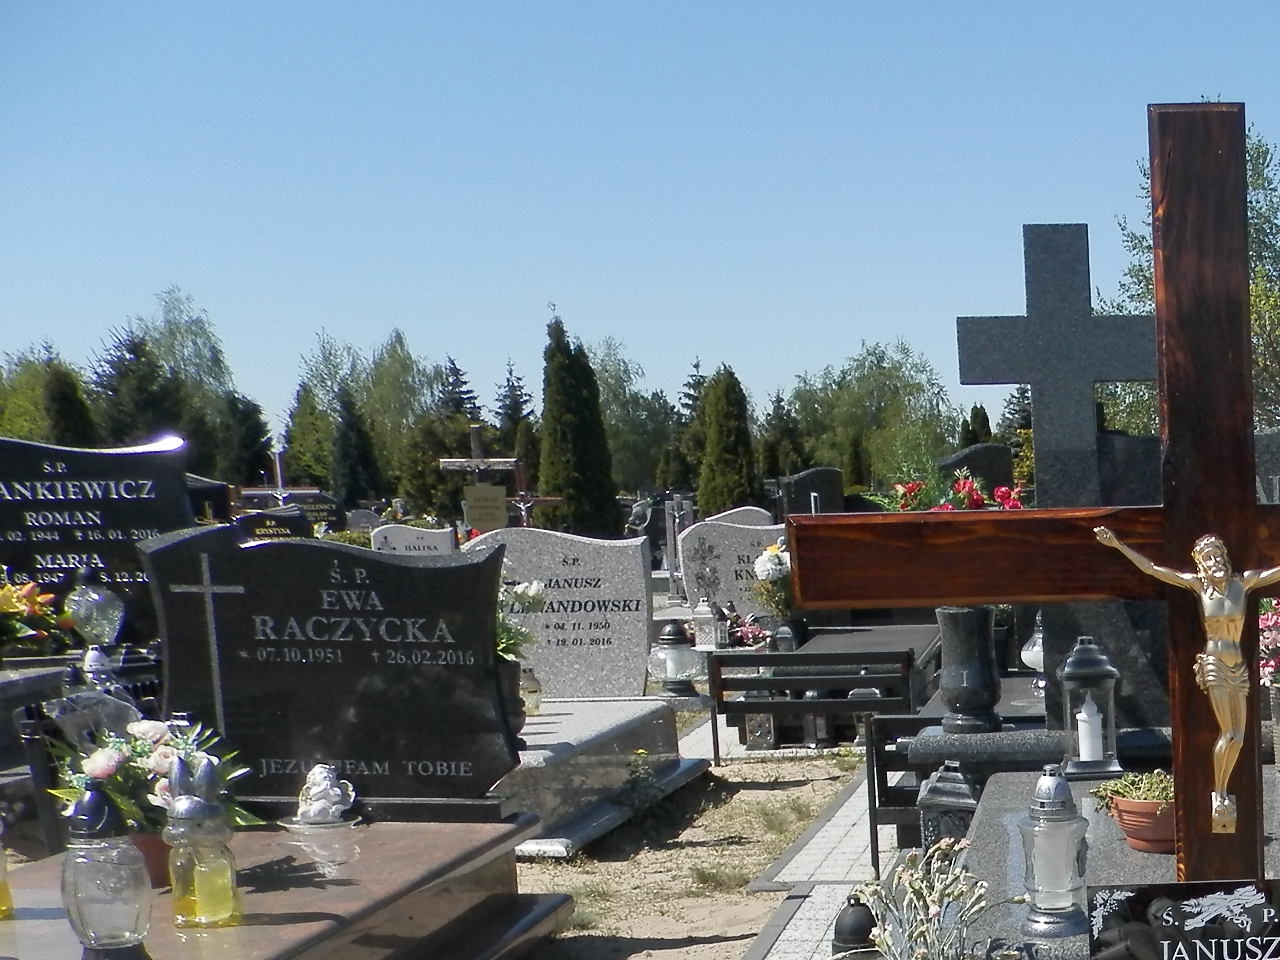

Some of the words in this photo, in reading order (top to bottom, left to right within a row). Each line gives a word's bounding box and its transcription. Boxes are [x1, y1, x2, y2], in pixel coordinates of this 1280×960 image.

[24, 510, 102, 526] ROMAN
[35, 553, 105, 568] MARIA
[544, 578, 601, 589] JANUSZ
[319, 590, 385, 611] EWA
[252, 615, 456, 643] RACZYCKA
[402, 760, 474, 777] TOBIE
[1262, 908, 1279, 924] P.
